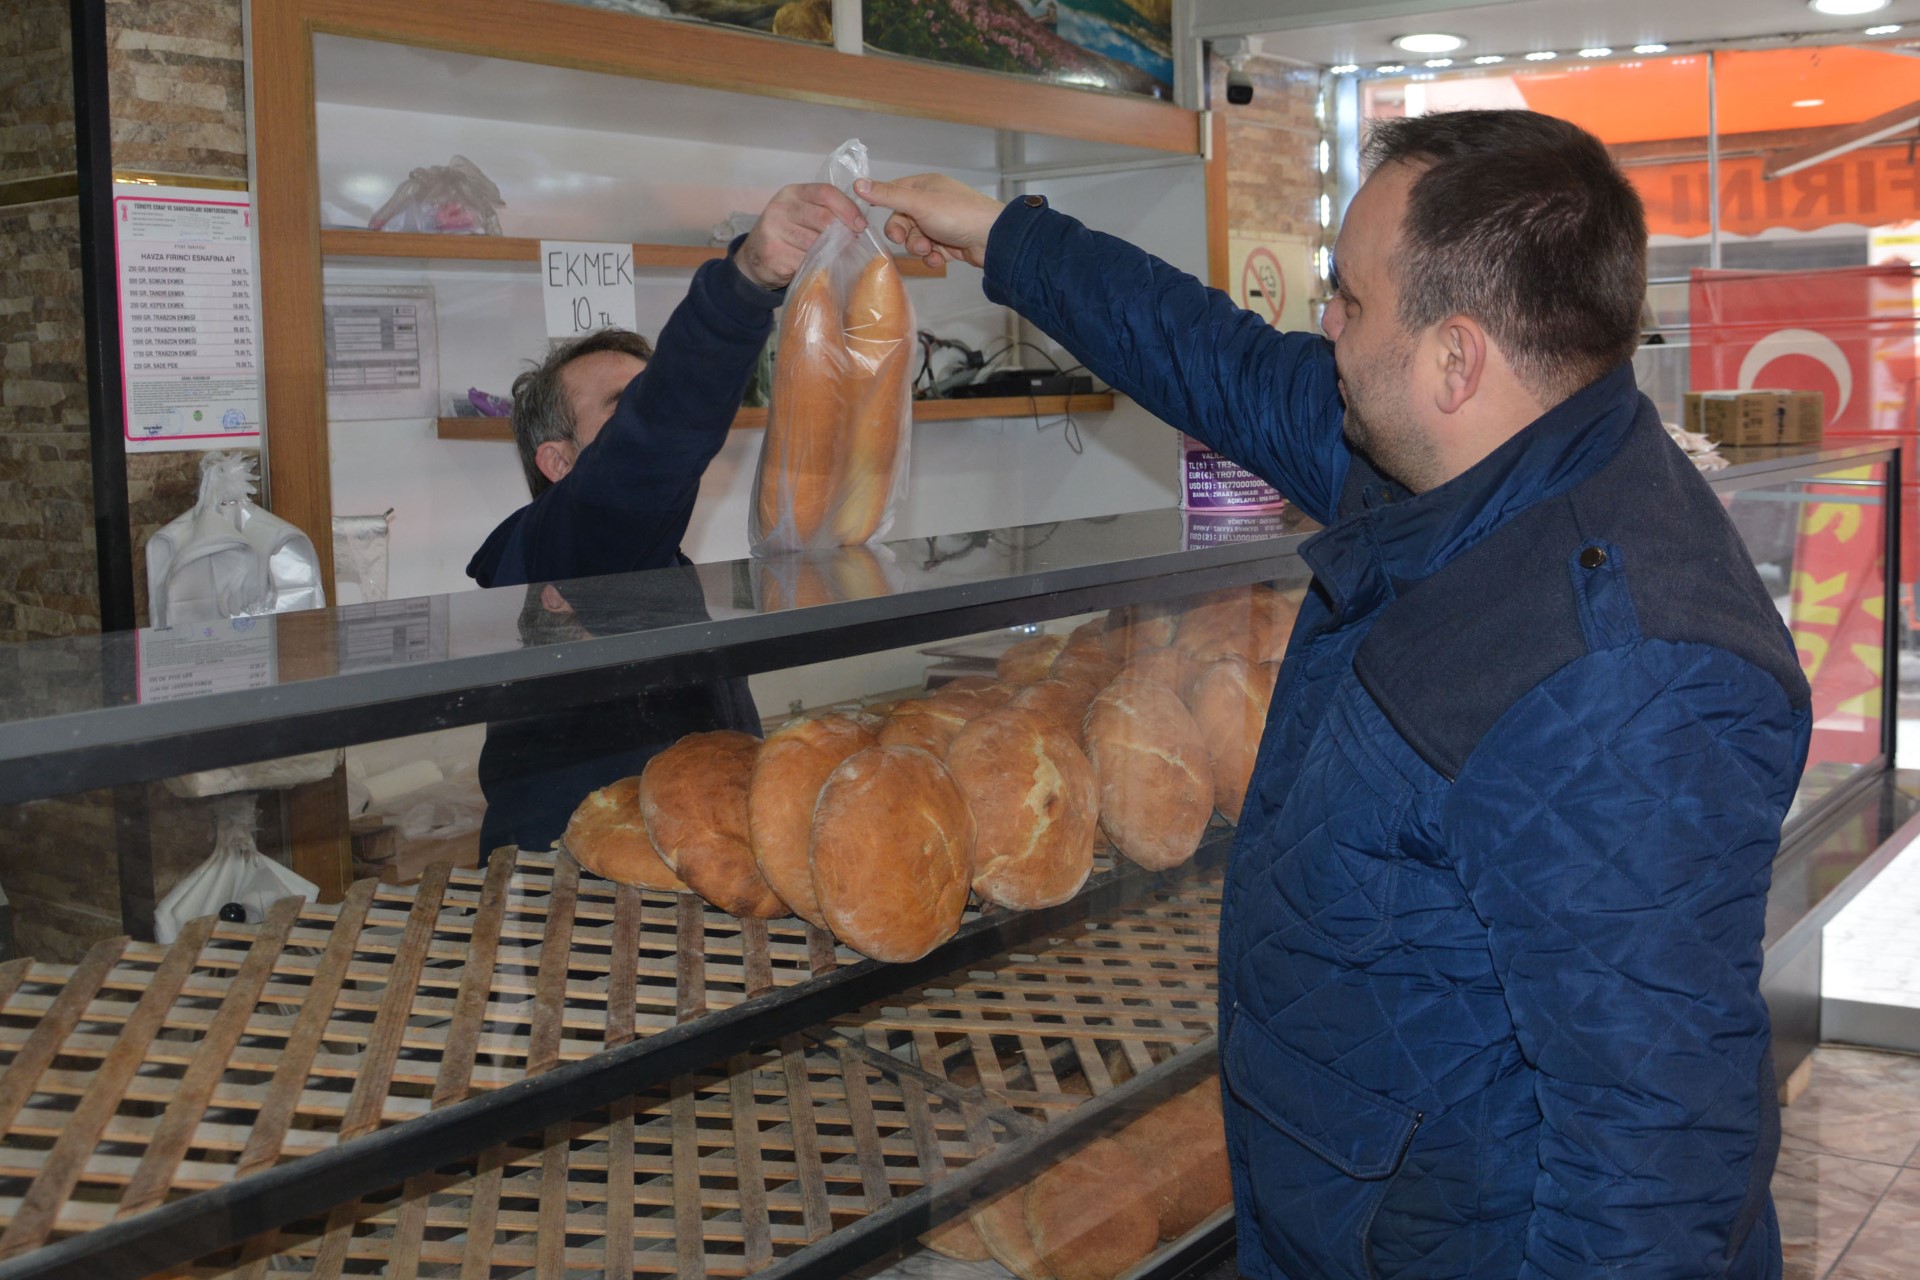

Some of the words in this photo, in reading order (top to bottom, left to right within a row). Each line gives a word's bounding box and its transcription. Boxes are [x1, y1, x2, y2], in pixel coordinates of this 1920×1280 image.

[192, 254, 224, 262] ESNAFINA
[548, 251, 632, 287] EKMEK
[572, 297, 592, 332] 10
